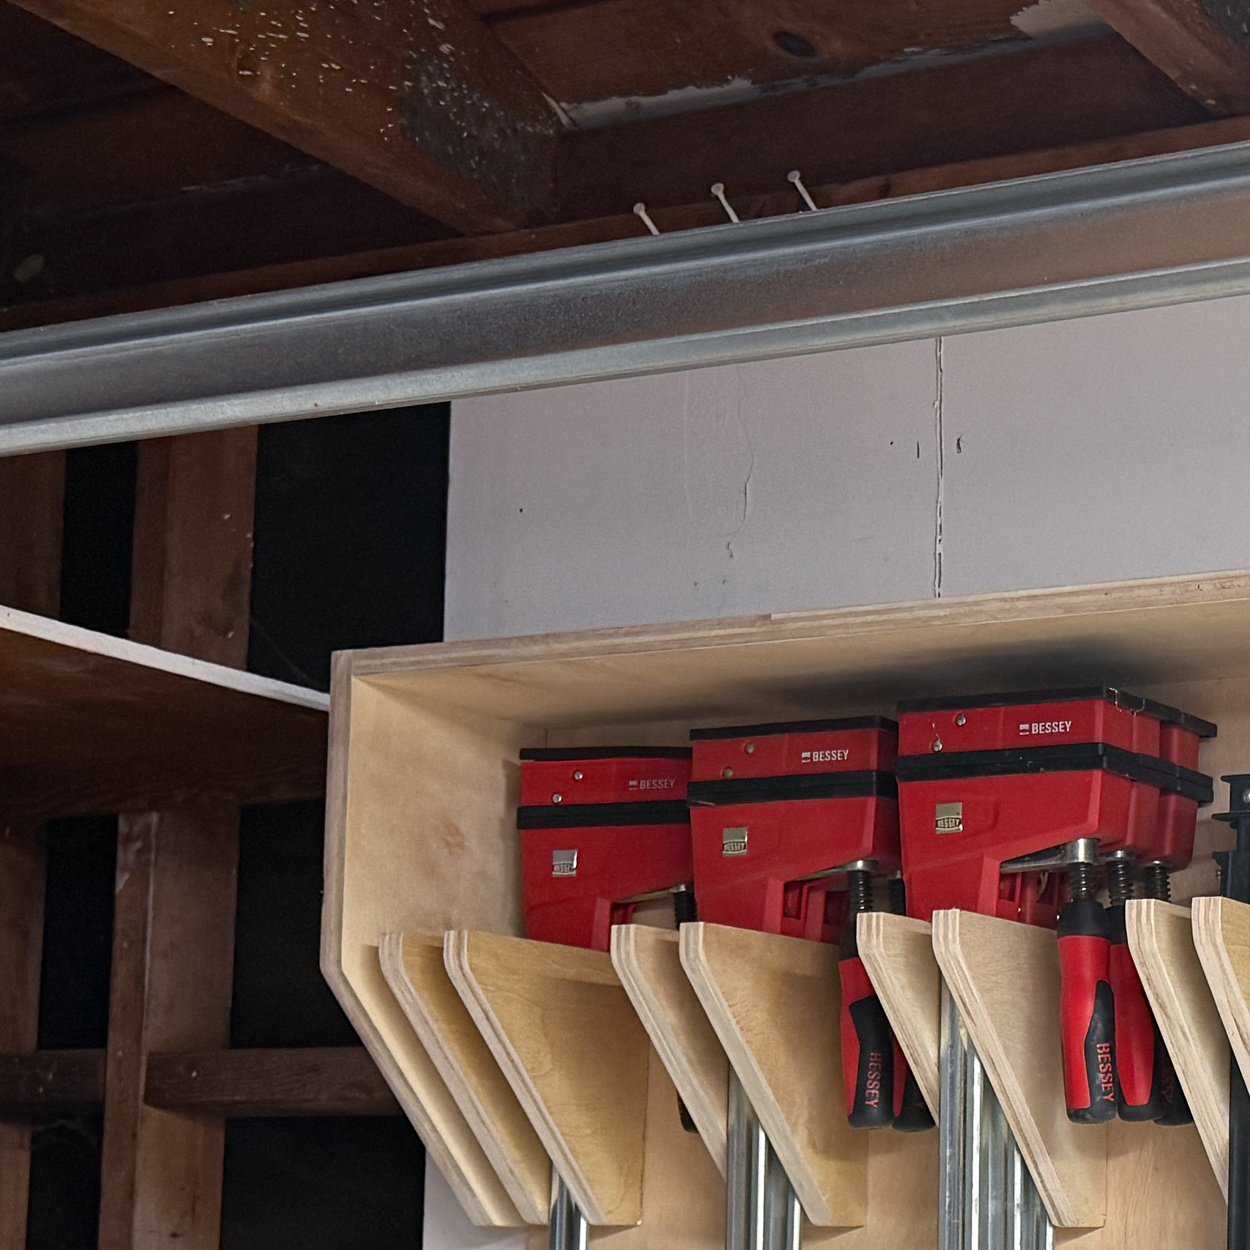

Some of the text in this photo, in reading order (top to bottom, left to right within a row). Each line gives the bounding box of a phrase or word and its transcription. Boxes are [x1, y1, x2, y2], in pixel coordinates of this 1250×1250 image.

[1031, 720, 1072, 734] BESSEY
[812, 749, 849, 762] BESSEY
[640, 778, 676, 790] BESSEY
[1096, 1042, 1115, 1102] BESSEY
[865, 1052, 881, 1109] BESSEY
